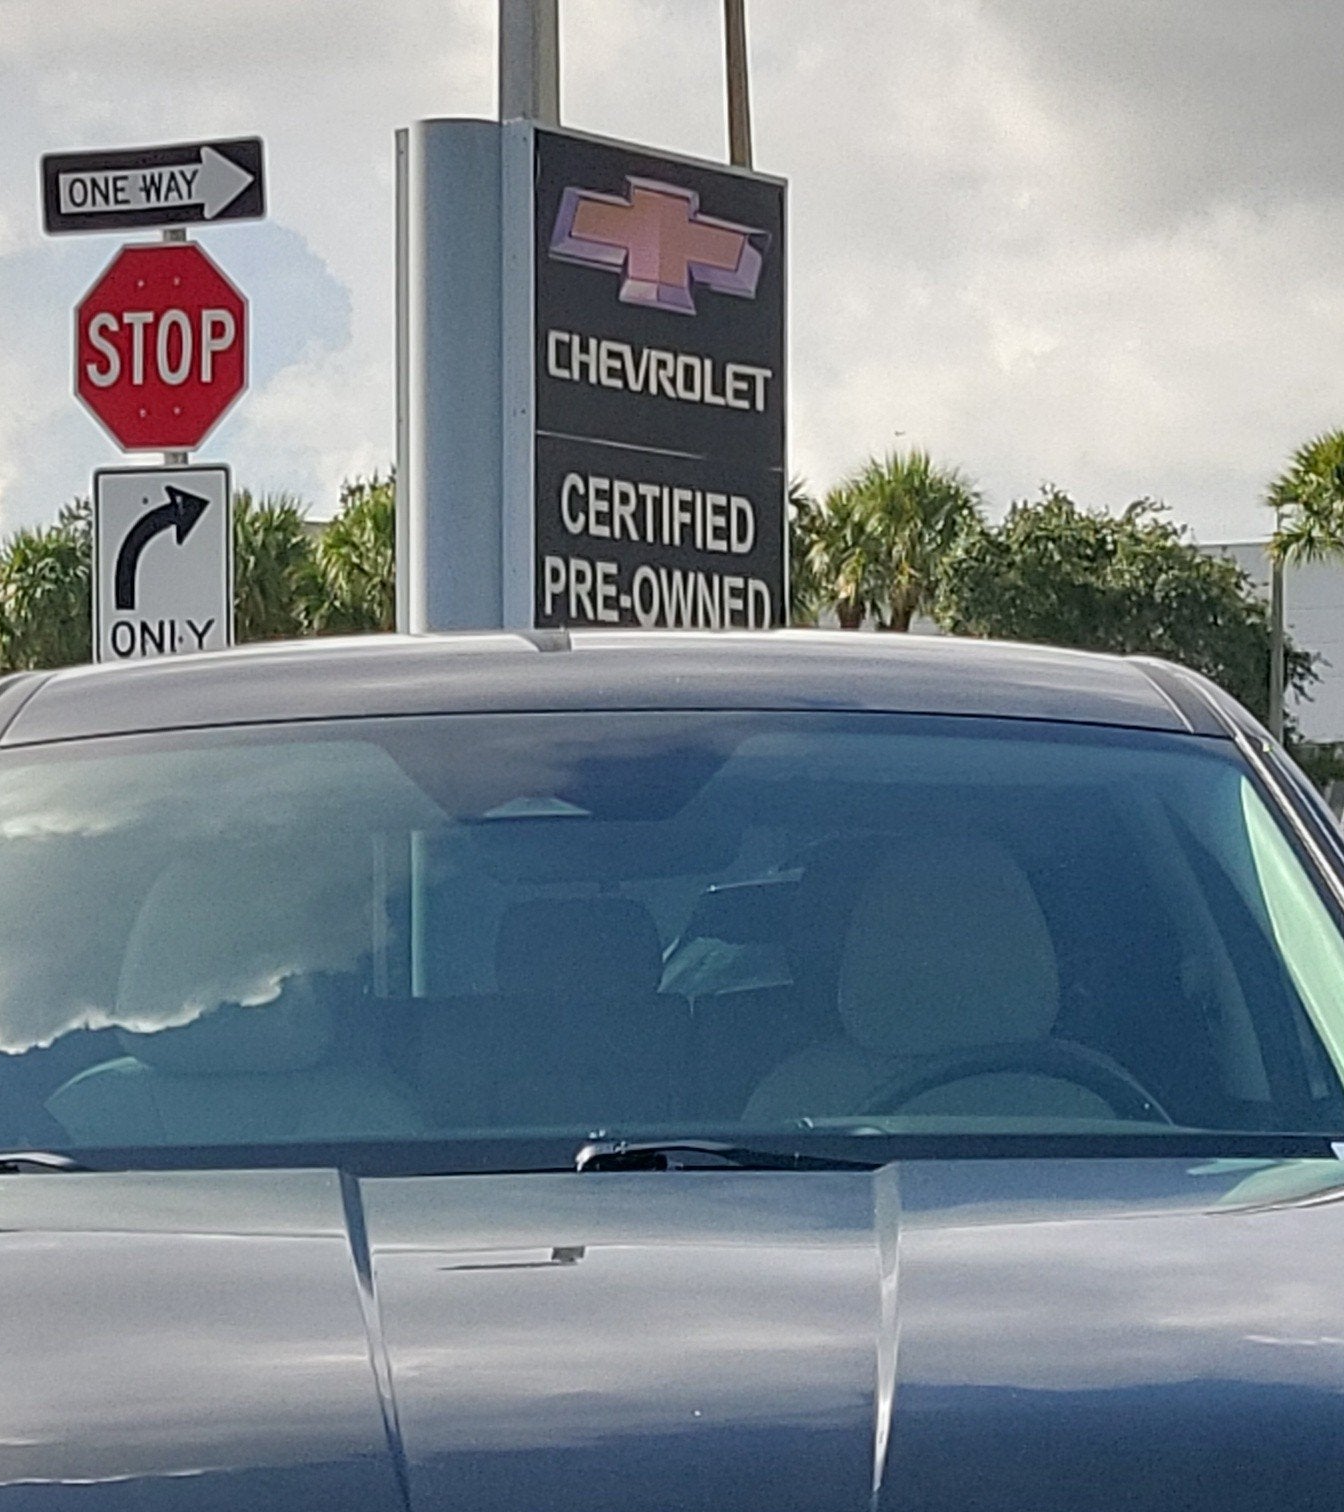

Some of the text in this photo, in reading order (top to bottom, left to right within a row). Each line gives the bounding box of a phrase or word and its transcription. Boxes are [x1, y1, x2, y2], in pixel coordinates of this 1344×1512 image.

[68, 169, 199, 208] ONE WAY
[86, 308, 235, 387] STOP
[548, 329, 772, 413] CHEVROLET
[560, 472, 755, 553] CERTIFIED
[544, 555, 772, 630] PRE-OWNED
[111, 618, 215, 658] ONLY
